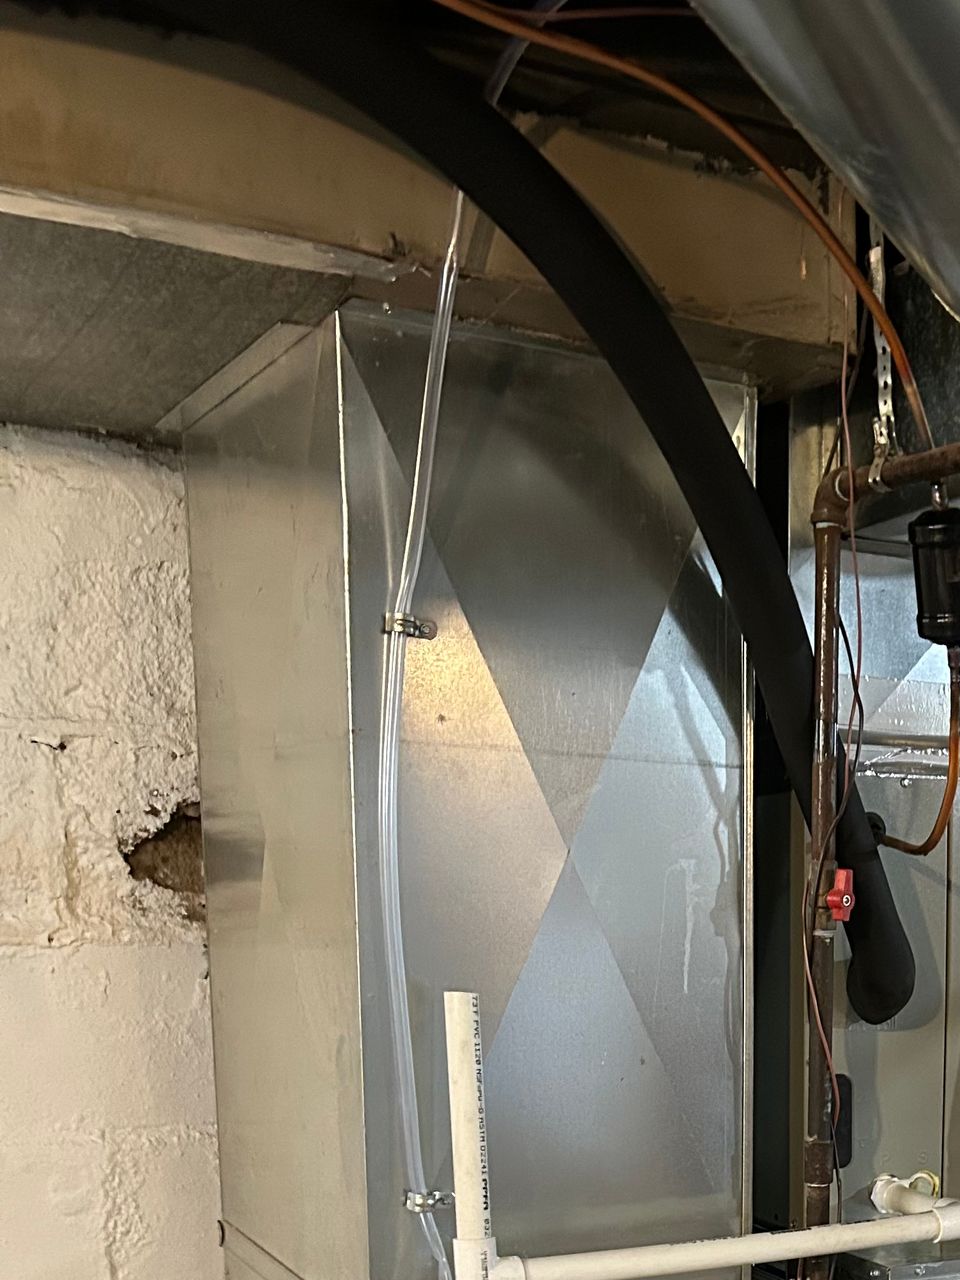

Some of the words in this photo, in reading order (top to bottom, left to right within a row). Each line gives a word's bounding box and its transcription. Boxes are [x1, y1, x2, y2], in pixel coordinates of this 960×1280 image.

[473, 1019, 481, 1039] PVC
[474, 1042, 482, 1066] 1120
[478, 1117, 486, 1142] ASTM
[480, 1145, 488, 1175] D2241
